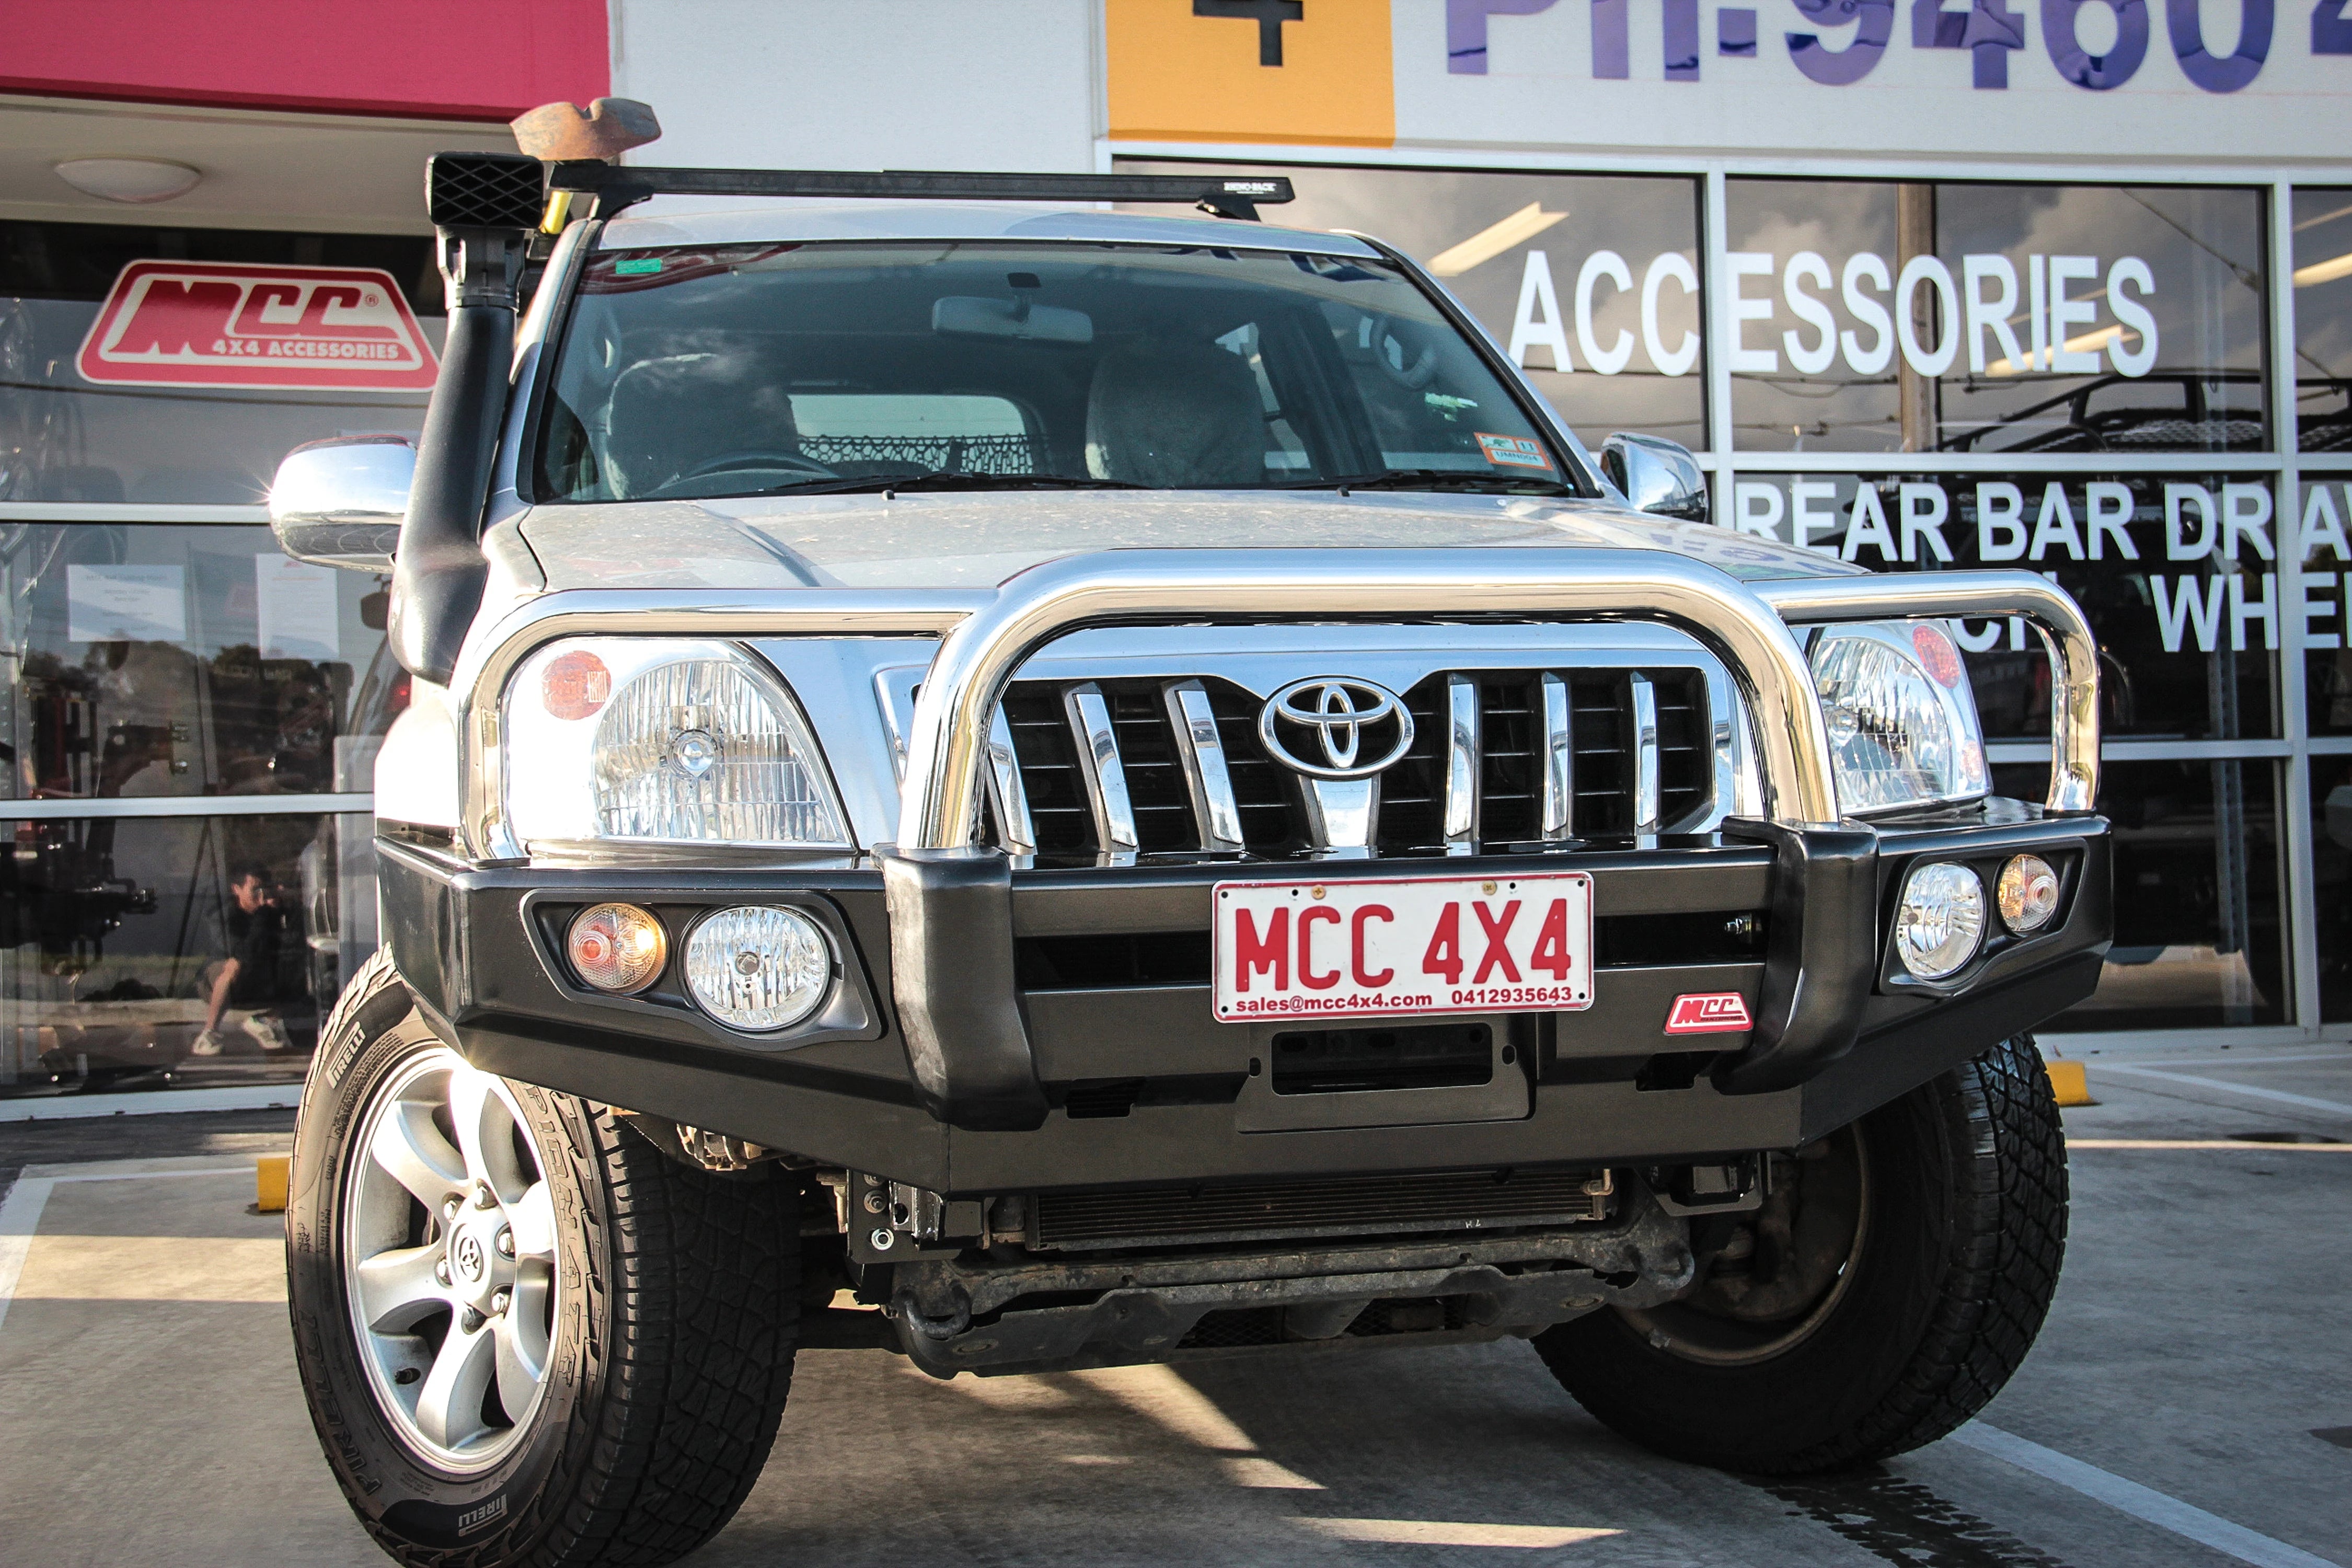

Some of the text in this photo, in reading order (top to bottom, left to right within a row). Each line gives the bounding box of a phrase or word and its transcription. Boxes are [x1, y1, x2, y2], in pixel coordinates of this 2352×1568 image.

[108, 280, 401, 355] MCC
[1508, 250, 2159, 377] ACCESSORIES
[212, 340, 399, 360] 4X4 ACCESSORIES
[1735, 481, 2352, 562] REAR BAR DRA
[2150, 572, 2352, 653] WHE
[1236, 898, 1571, 992] MCC 4X4
[1236, 987, 1573, 1012] sales@mcc4x4.com 0412935643
[1673, 999, 1743, 1024] MCC
[326, 1021, 366, 1089] PIRELLI
[458, 1493, 508, 1537] PIRELLI
